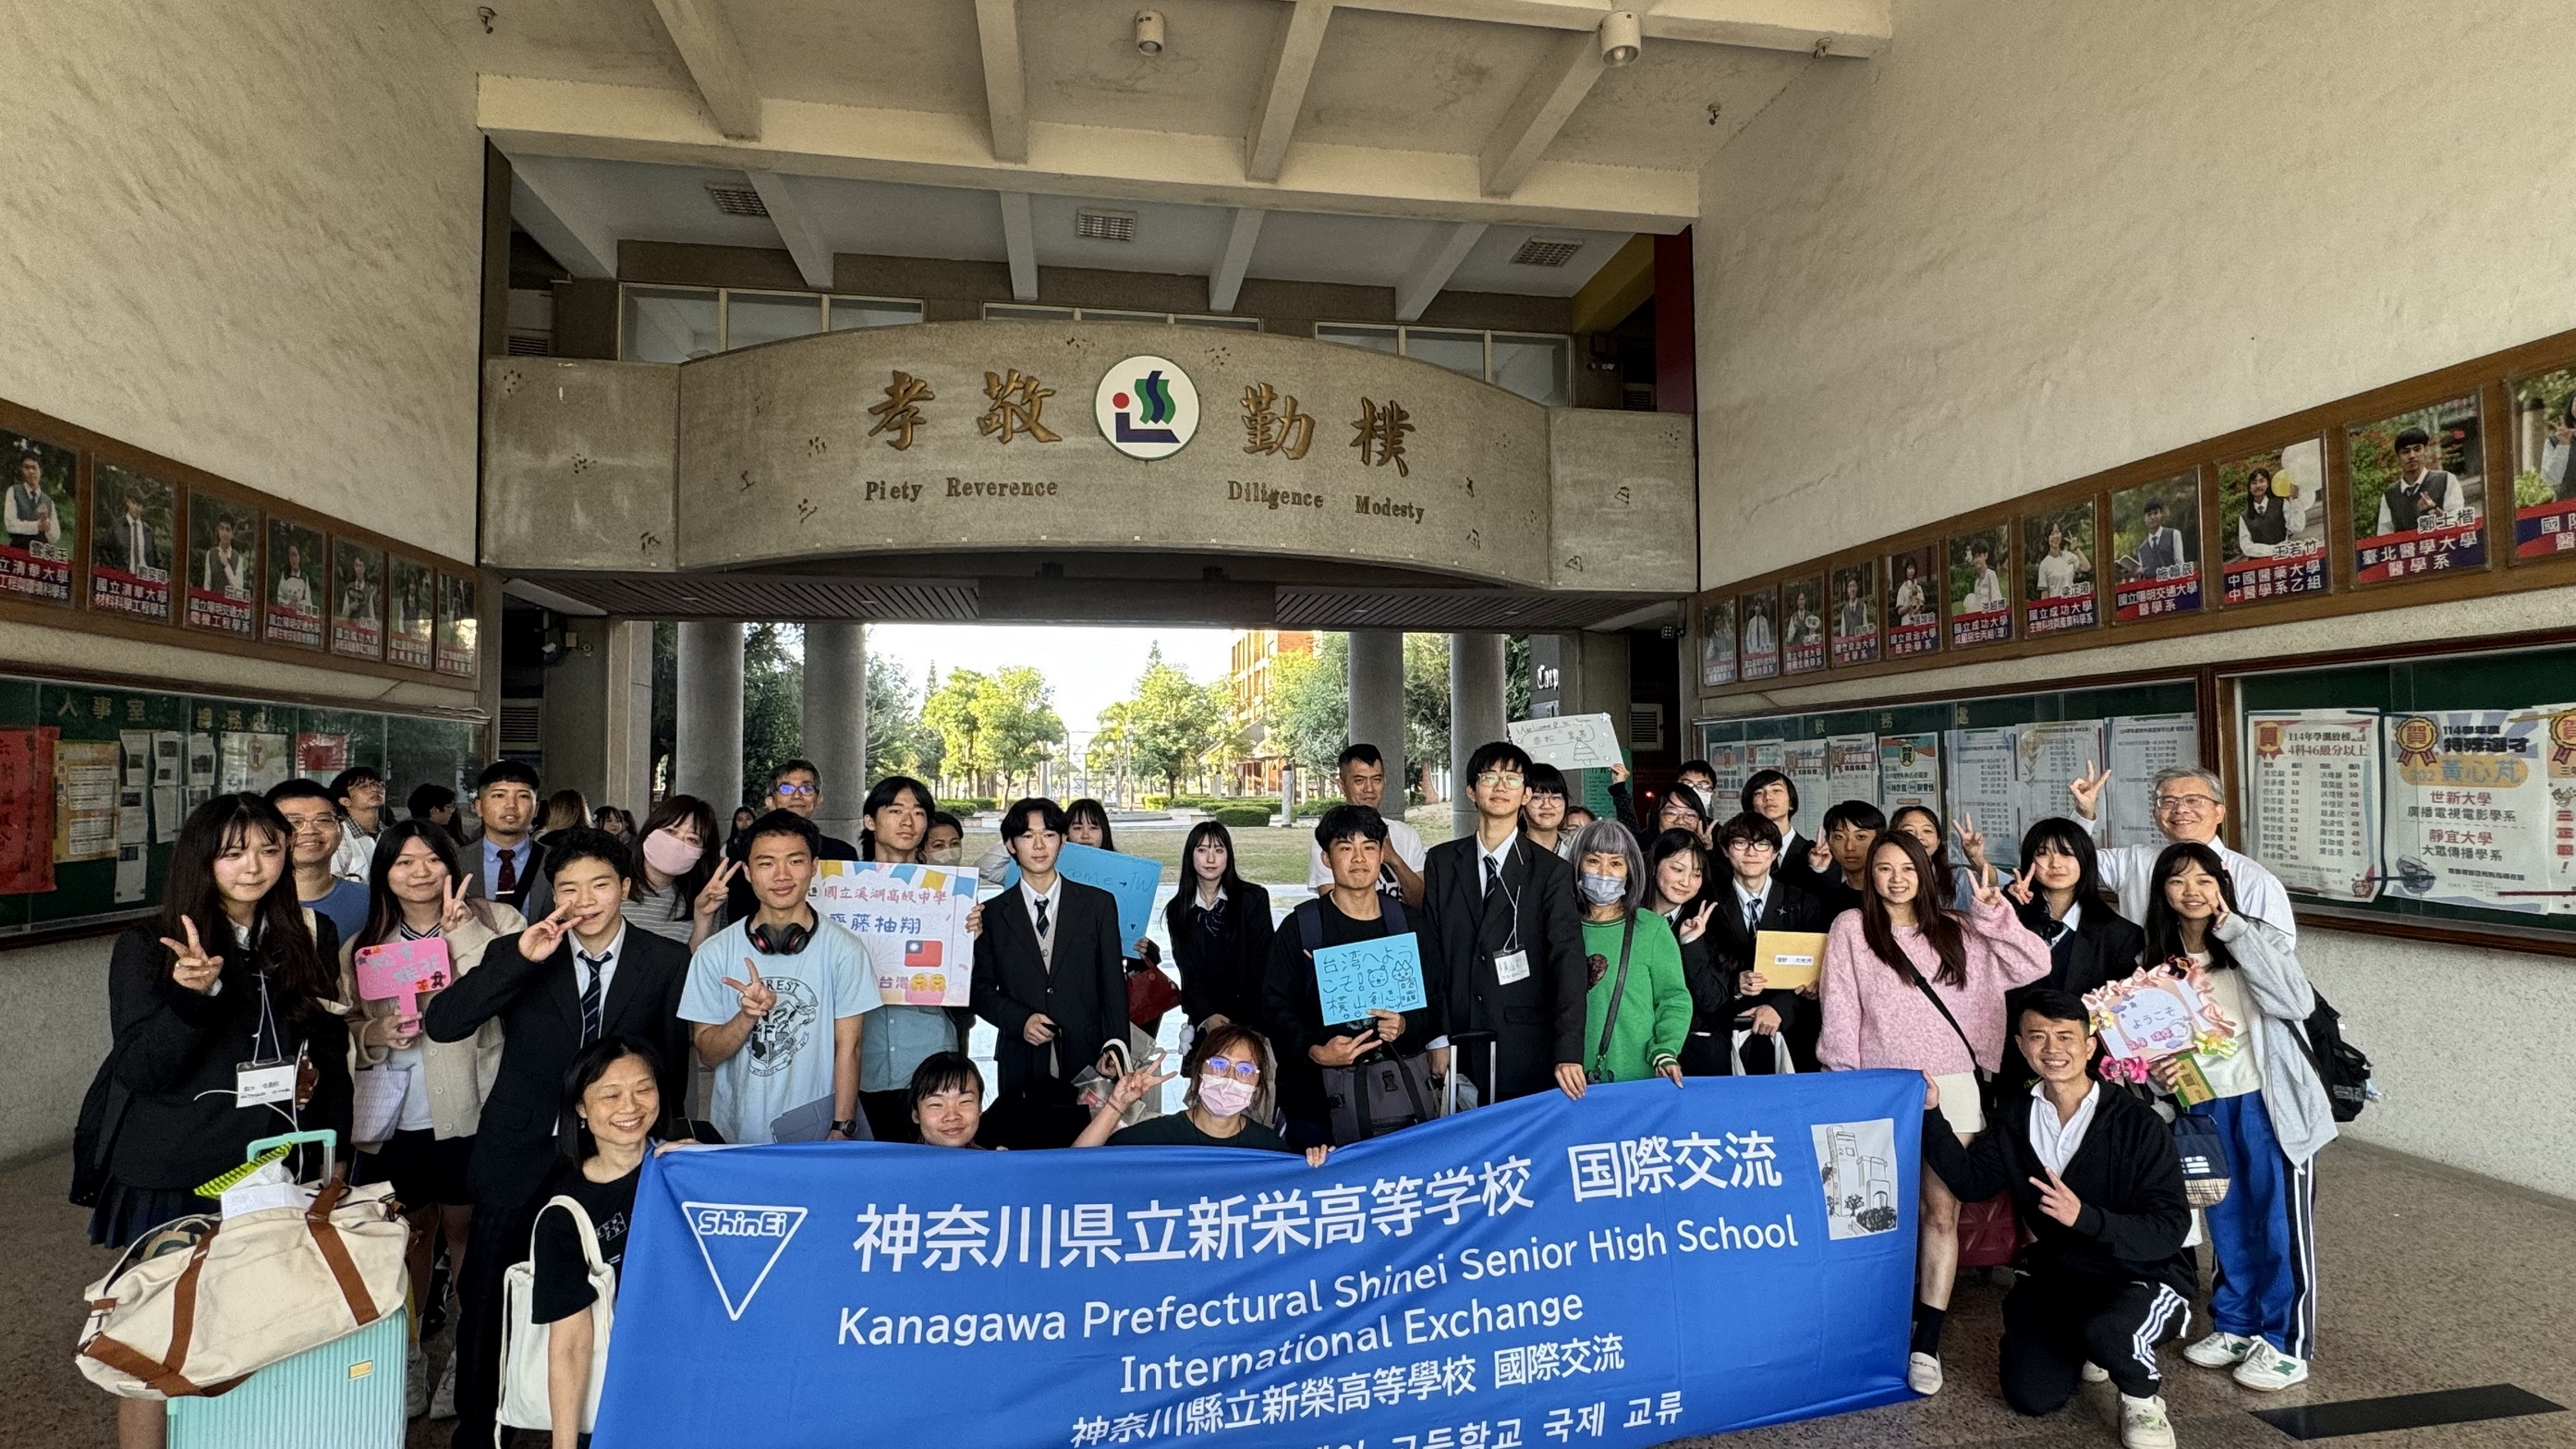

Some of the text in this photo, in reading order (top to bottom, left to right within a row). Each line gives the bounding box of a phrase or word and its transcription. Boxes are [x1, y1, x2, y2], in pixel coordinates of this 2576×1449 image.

[865, 477, 1426, 524] Piety Reverence Diligence Modesty
[2362, 532, 2478, 566] 臺北醫學大學
[2228, 559, 2321, 588] 中國醫藥大學
[2388, 554, 2450, 577] 醫學系
[2229, 575, 2322, 602] 中醫學系乙組
[2029, 600, 2093, 621] 國立成功大學
[2138, 599, 2177, 616] 醫學系
[2430, 791, 2492, 806] 世新大學
[2408, 806, 2517, 822] 廣播電視電影學系
[2429, 829, 2493, 846] 靜宜大學
[760, 980, 801, 993] REST
[2132, 1006, 2176, 1029] ようこそ
[853, 1130, 1783, 1273] 神奈川県立新栄高等学校 国際交流
[698, 1210, 787, 1237] ShinEi
[838, 1212, 1799, 1346] Kanagawa Prefectural Shinei Senior High School
[1120, 1293, 1584, 1394] International Exchange
[1070, 1332, 1625, 1449] 神奈川縣立新榮高等學校 國際交流
[1543, 1401, 1606, 1443] 국제
[1622, 1390, 1684, 1429] 교류
